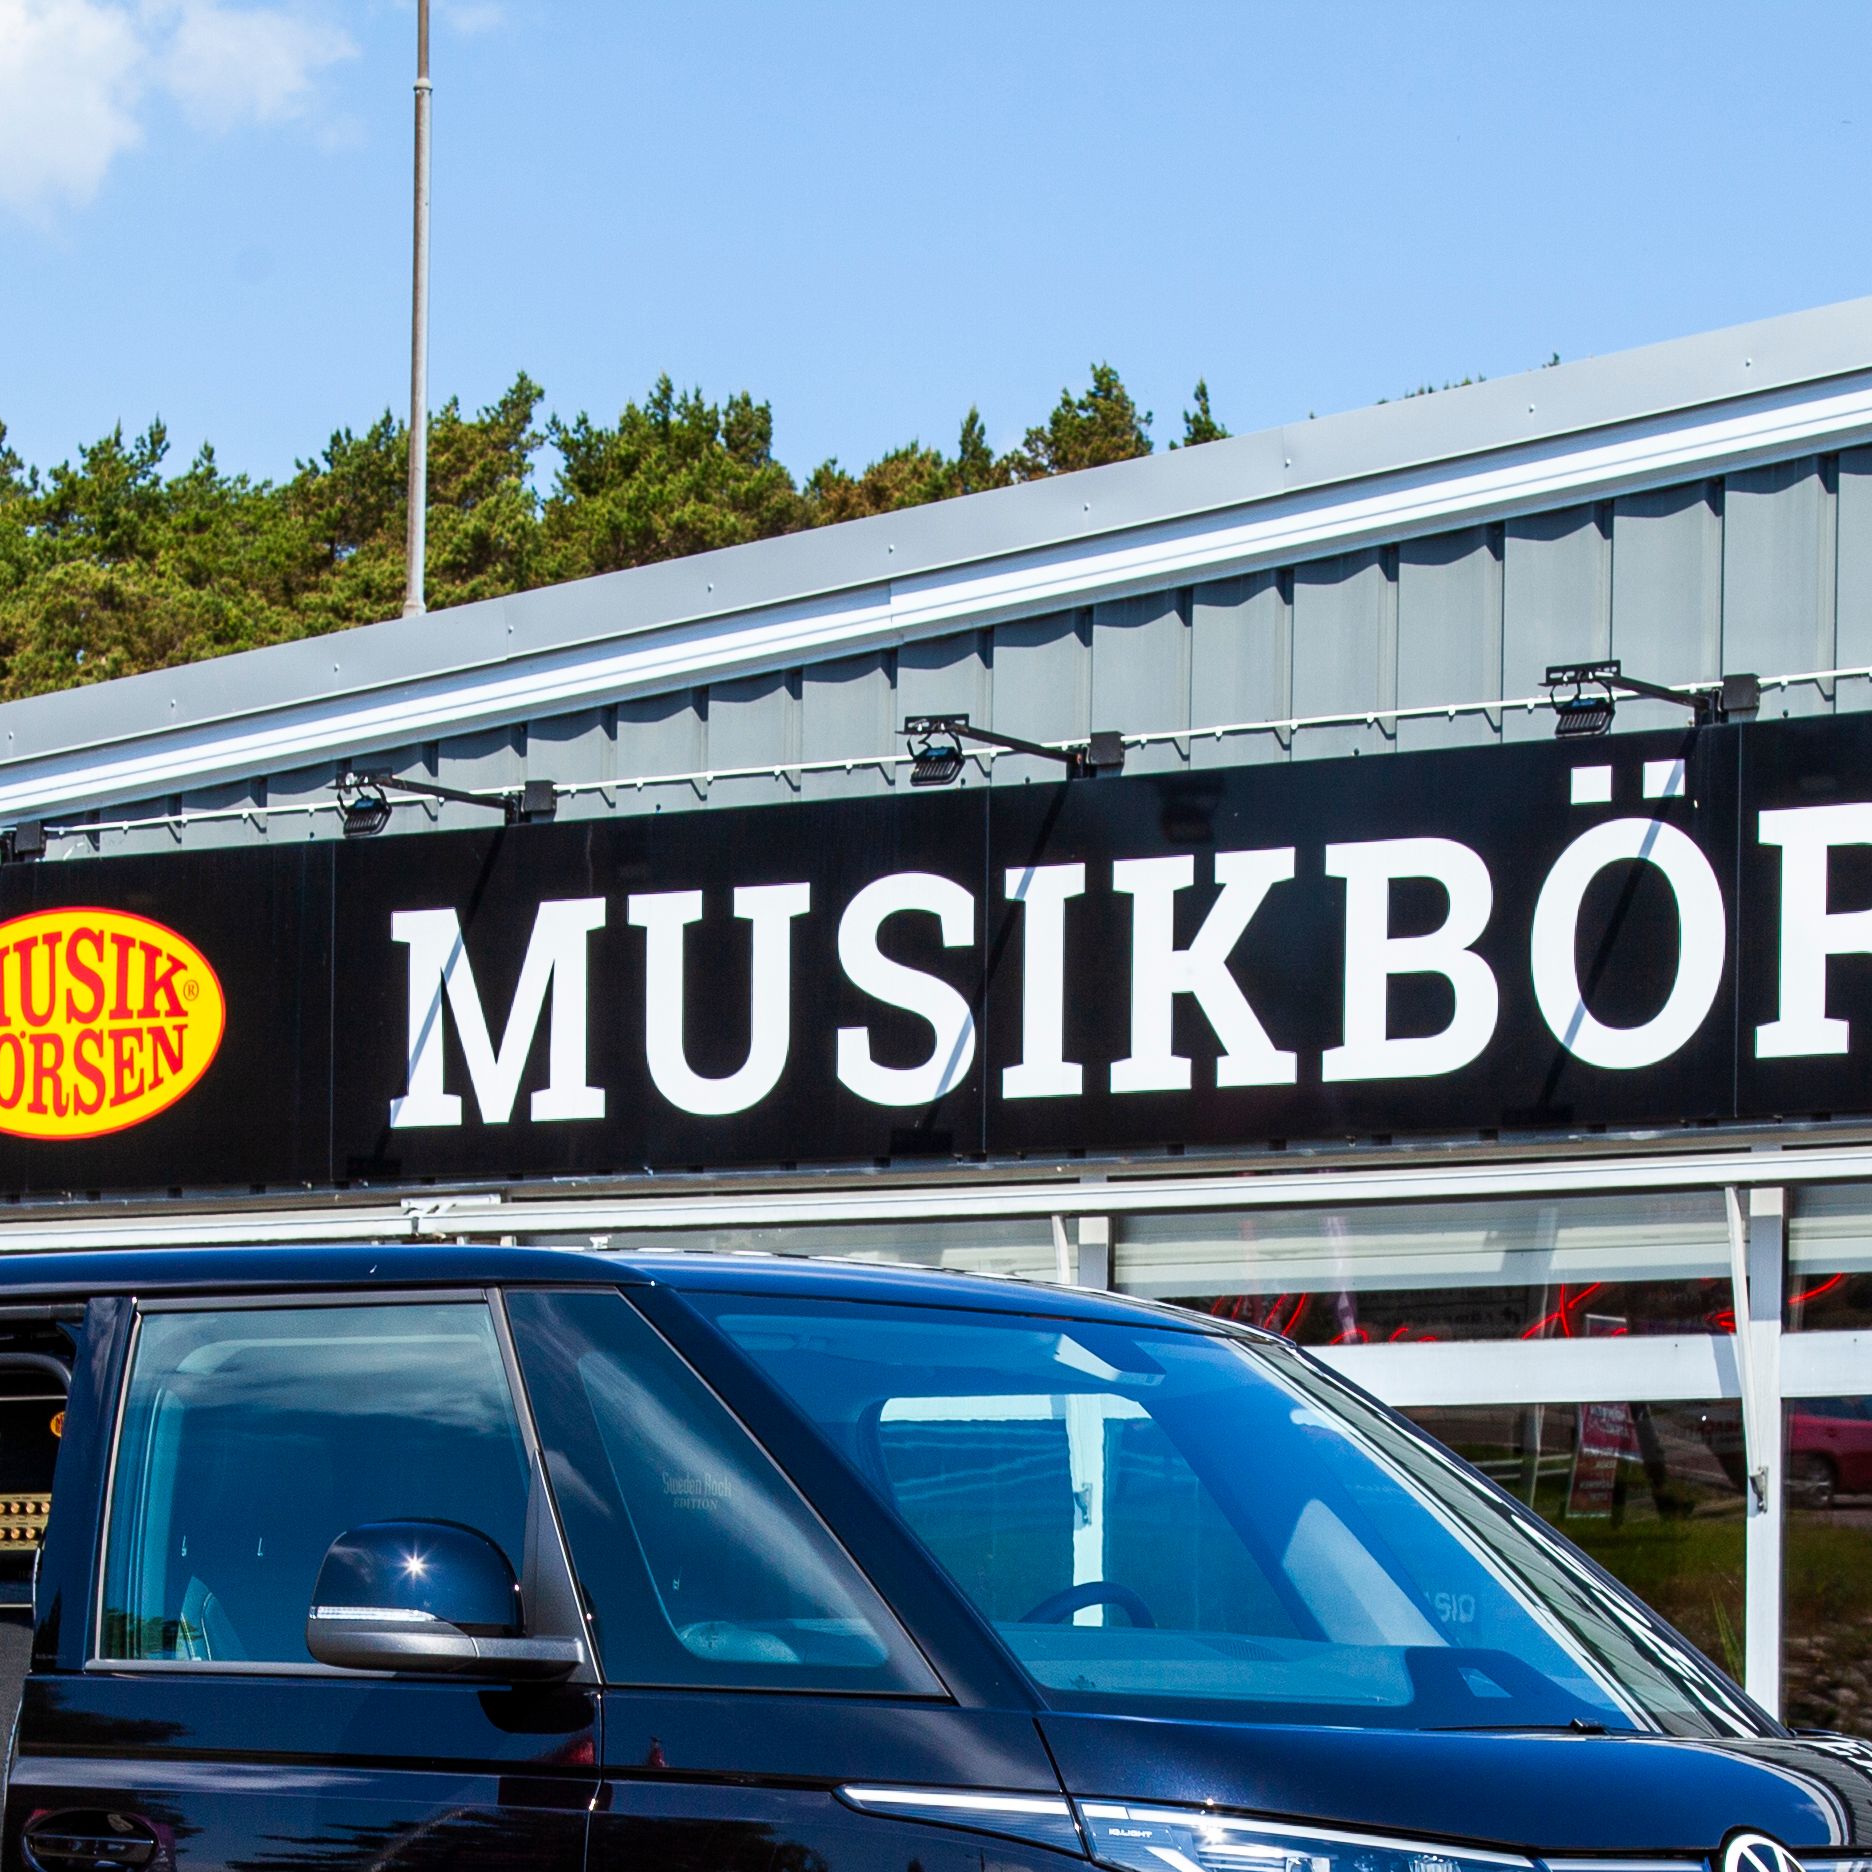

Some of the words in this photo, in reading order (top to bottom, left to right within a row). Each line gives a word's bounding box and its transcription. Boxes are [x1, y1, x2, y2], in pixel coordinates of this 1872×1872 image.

[662, 1471, 703, 1496] Sweden
[704, 1472, 732, 1498] Rock
[673, 1497, 719, 1510] EDITION
